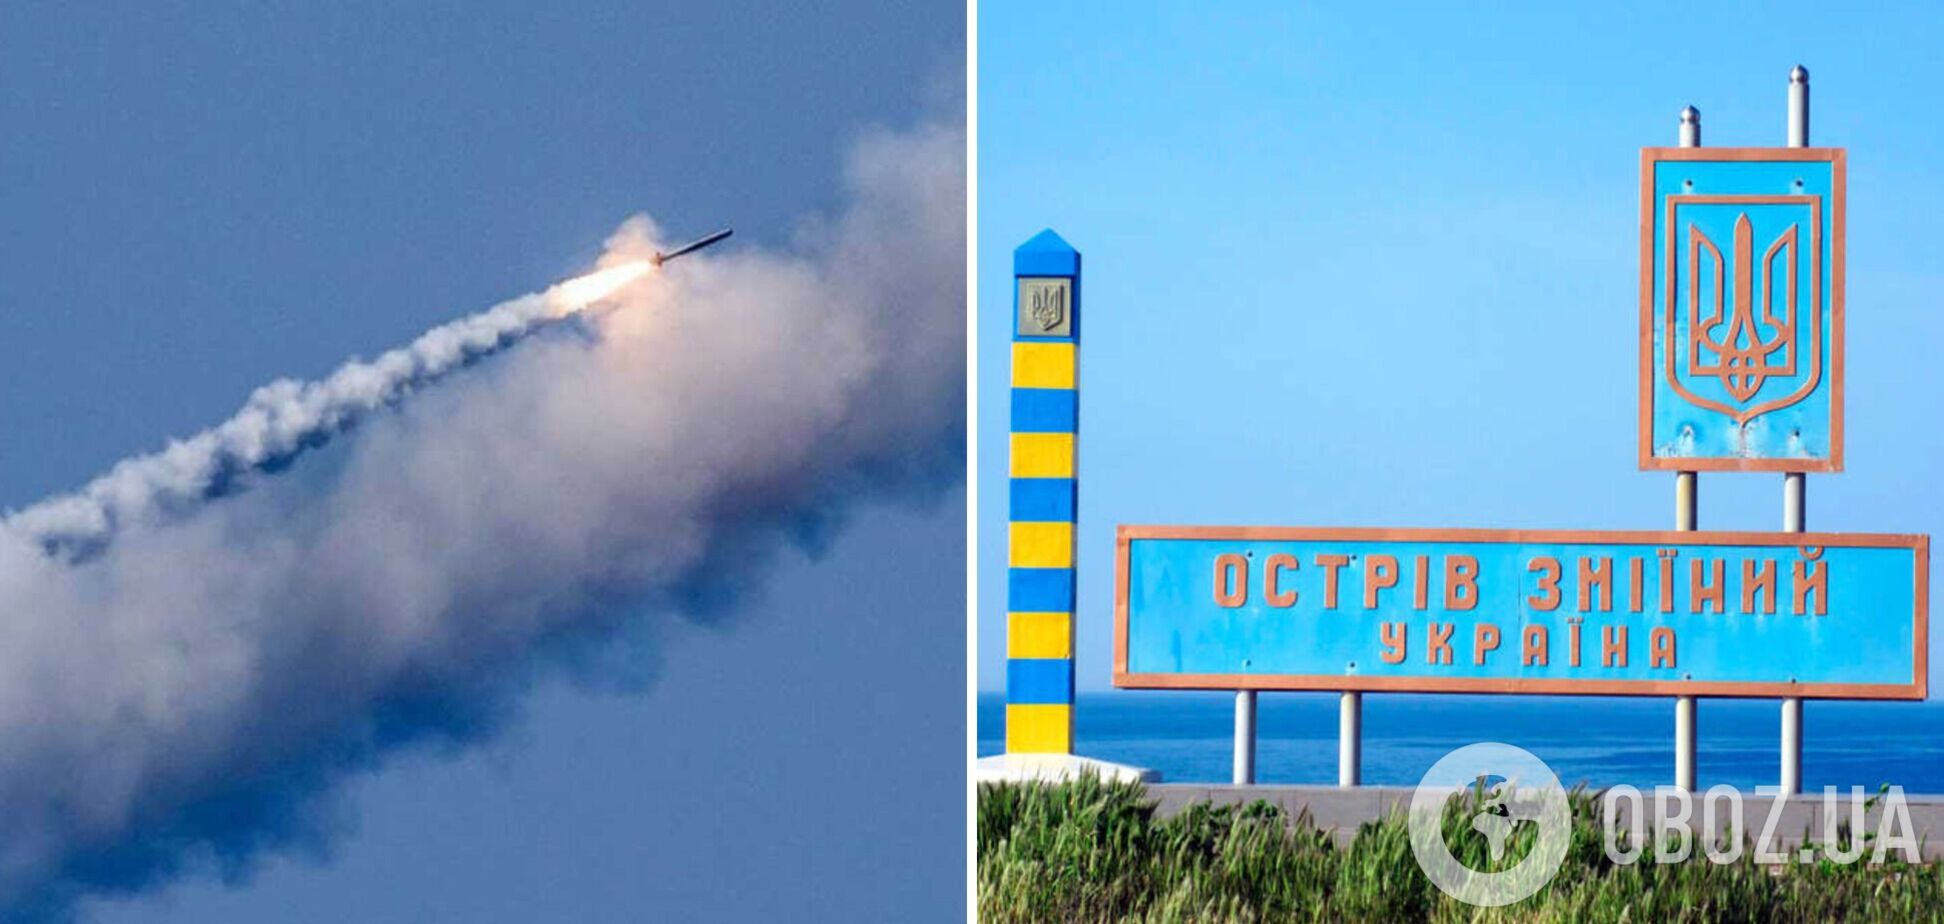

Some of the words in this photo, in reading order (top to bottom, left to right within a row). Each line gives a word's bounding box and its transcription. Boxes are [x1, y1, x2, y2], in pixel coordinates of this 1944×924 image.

[1213, 554, 1479, 609] ОСТРІВ
[1527, 546, 1828, 615] ЗМІЇНИЙ
[1380, 618, 1677, 668] УКРАЇНА
